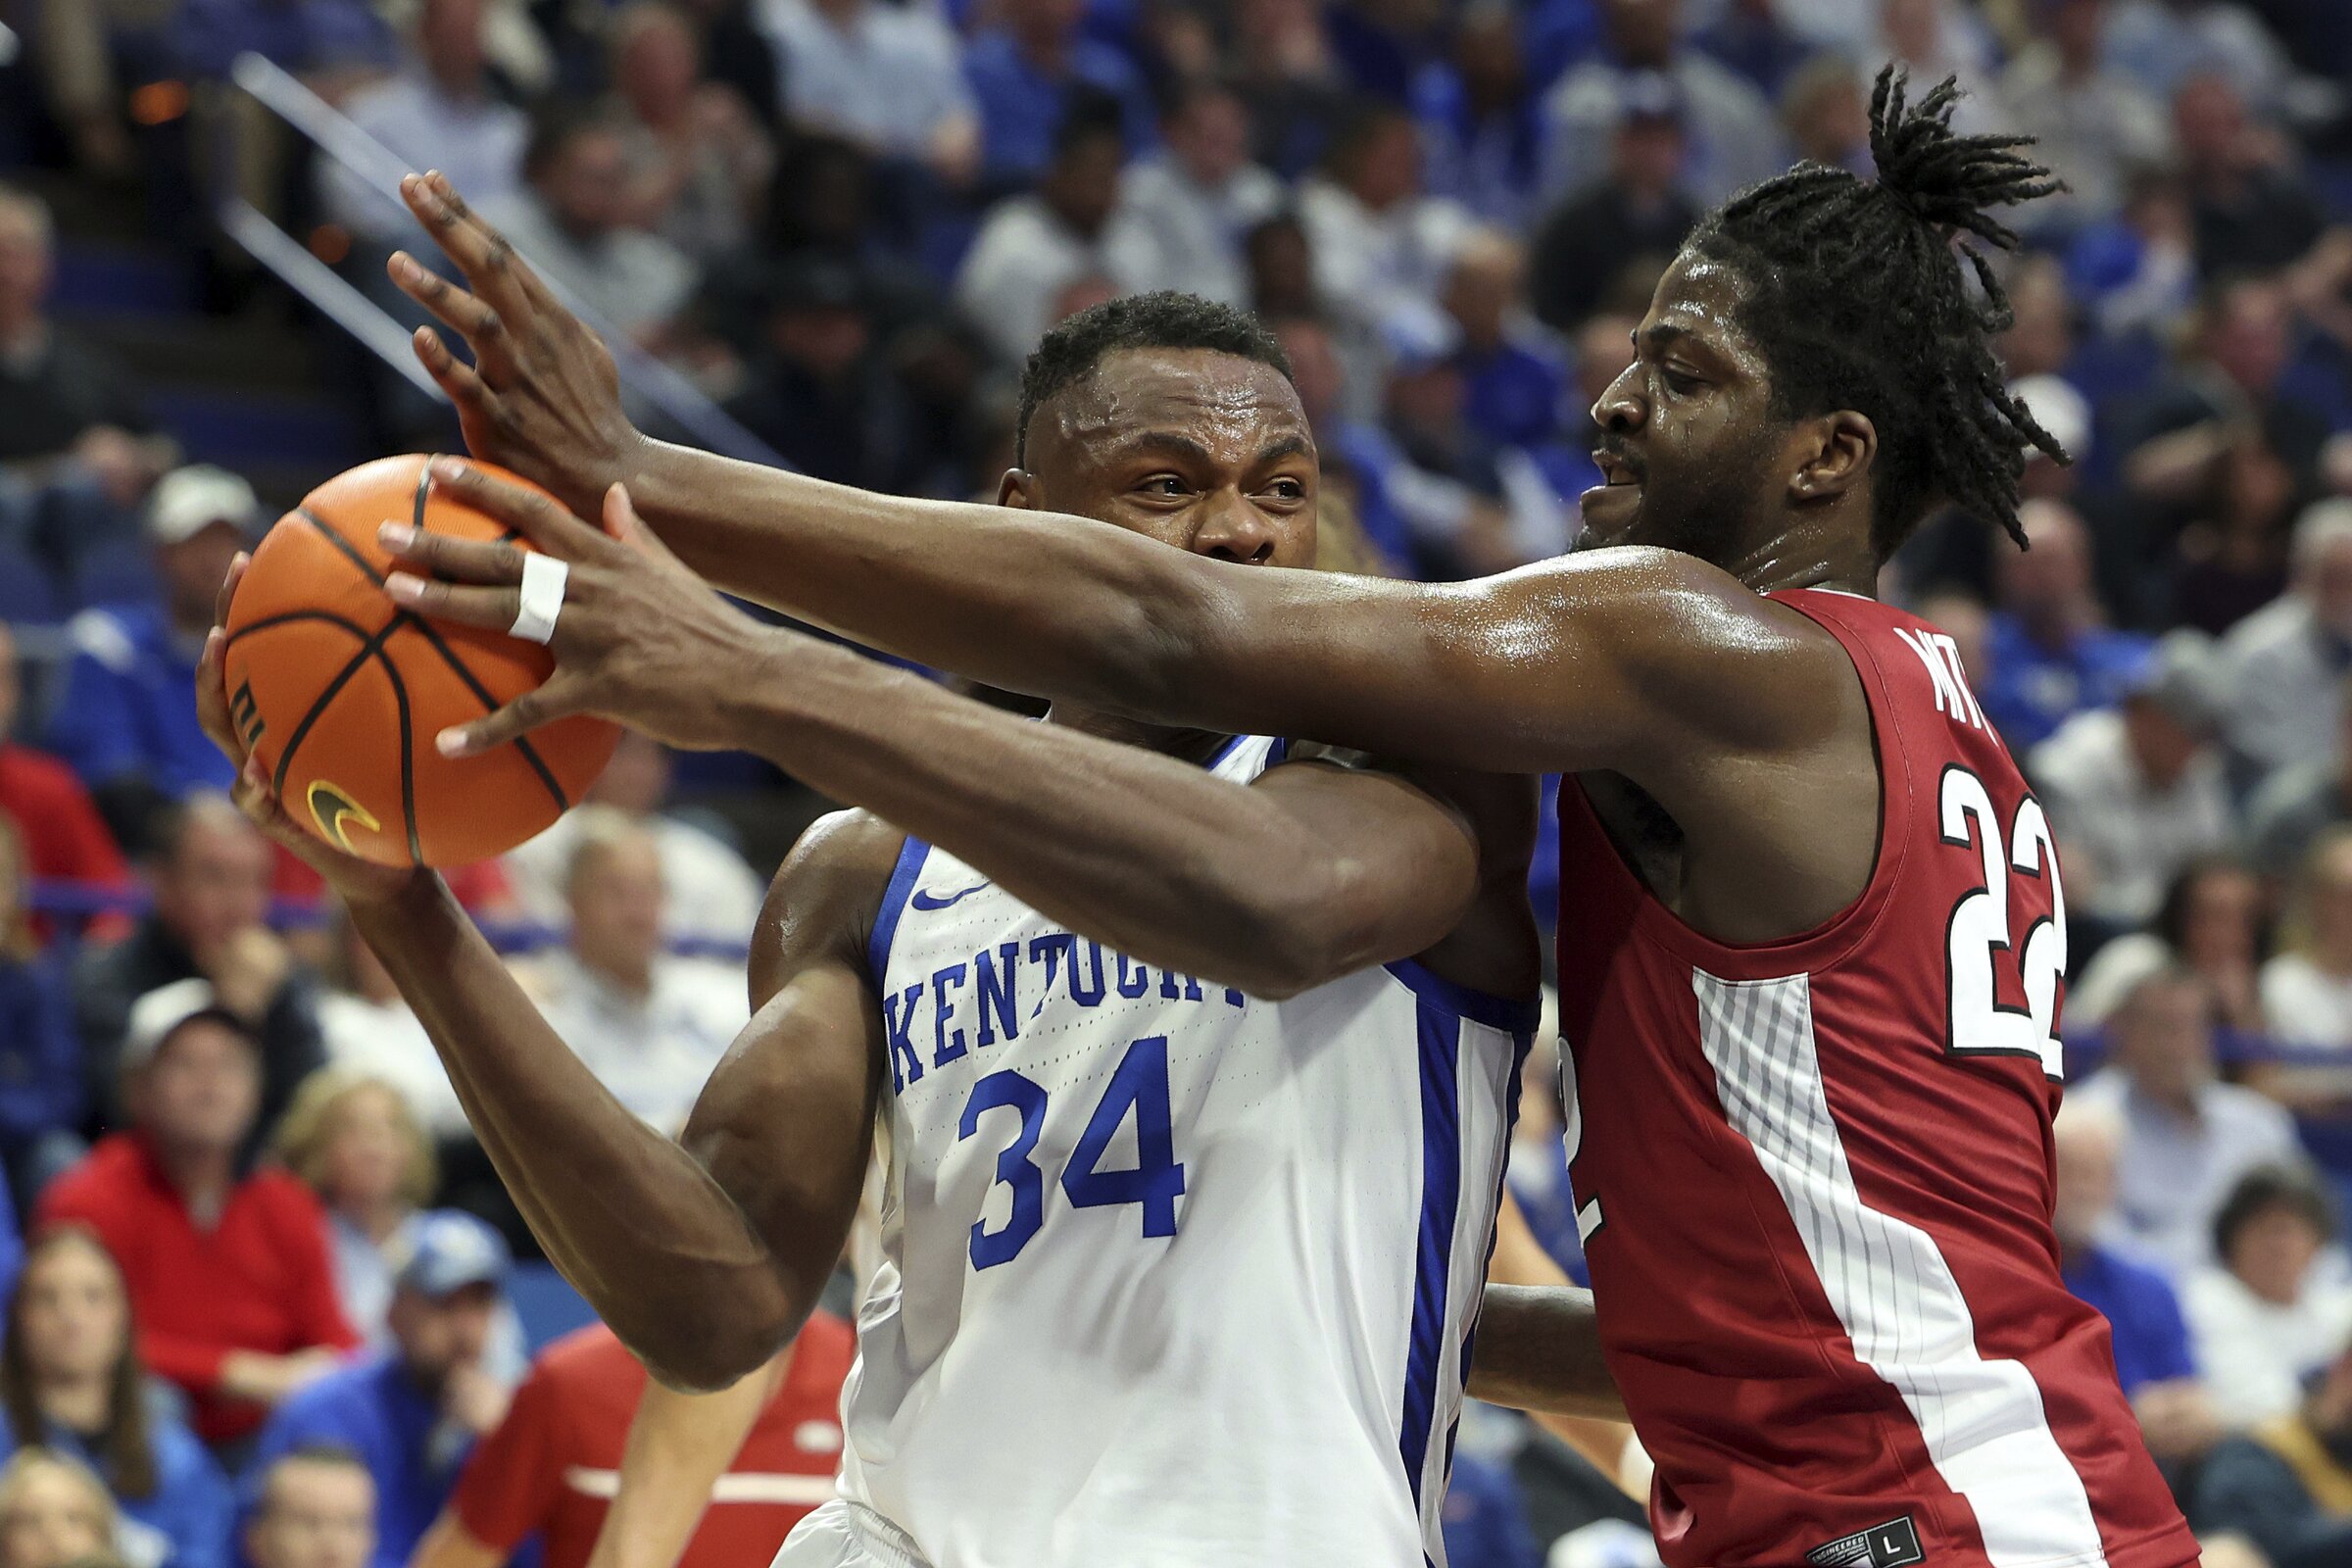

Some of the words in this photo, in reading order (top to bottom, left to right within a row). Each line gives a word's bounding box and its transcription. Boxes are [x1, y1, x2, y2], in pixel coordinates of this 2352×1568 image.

[1892, 627, 1998, 748] MIT
[1939, 763, 2067, 1082] 22
[884, 933, 1244, 1097] KENTUC
[958, 1036, 1184, 1271] 34
[1883, 1536, 1901, 1554] L
